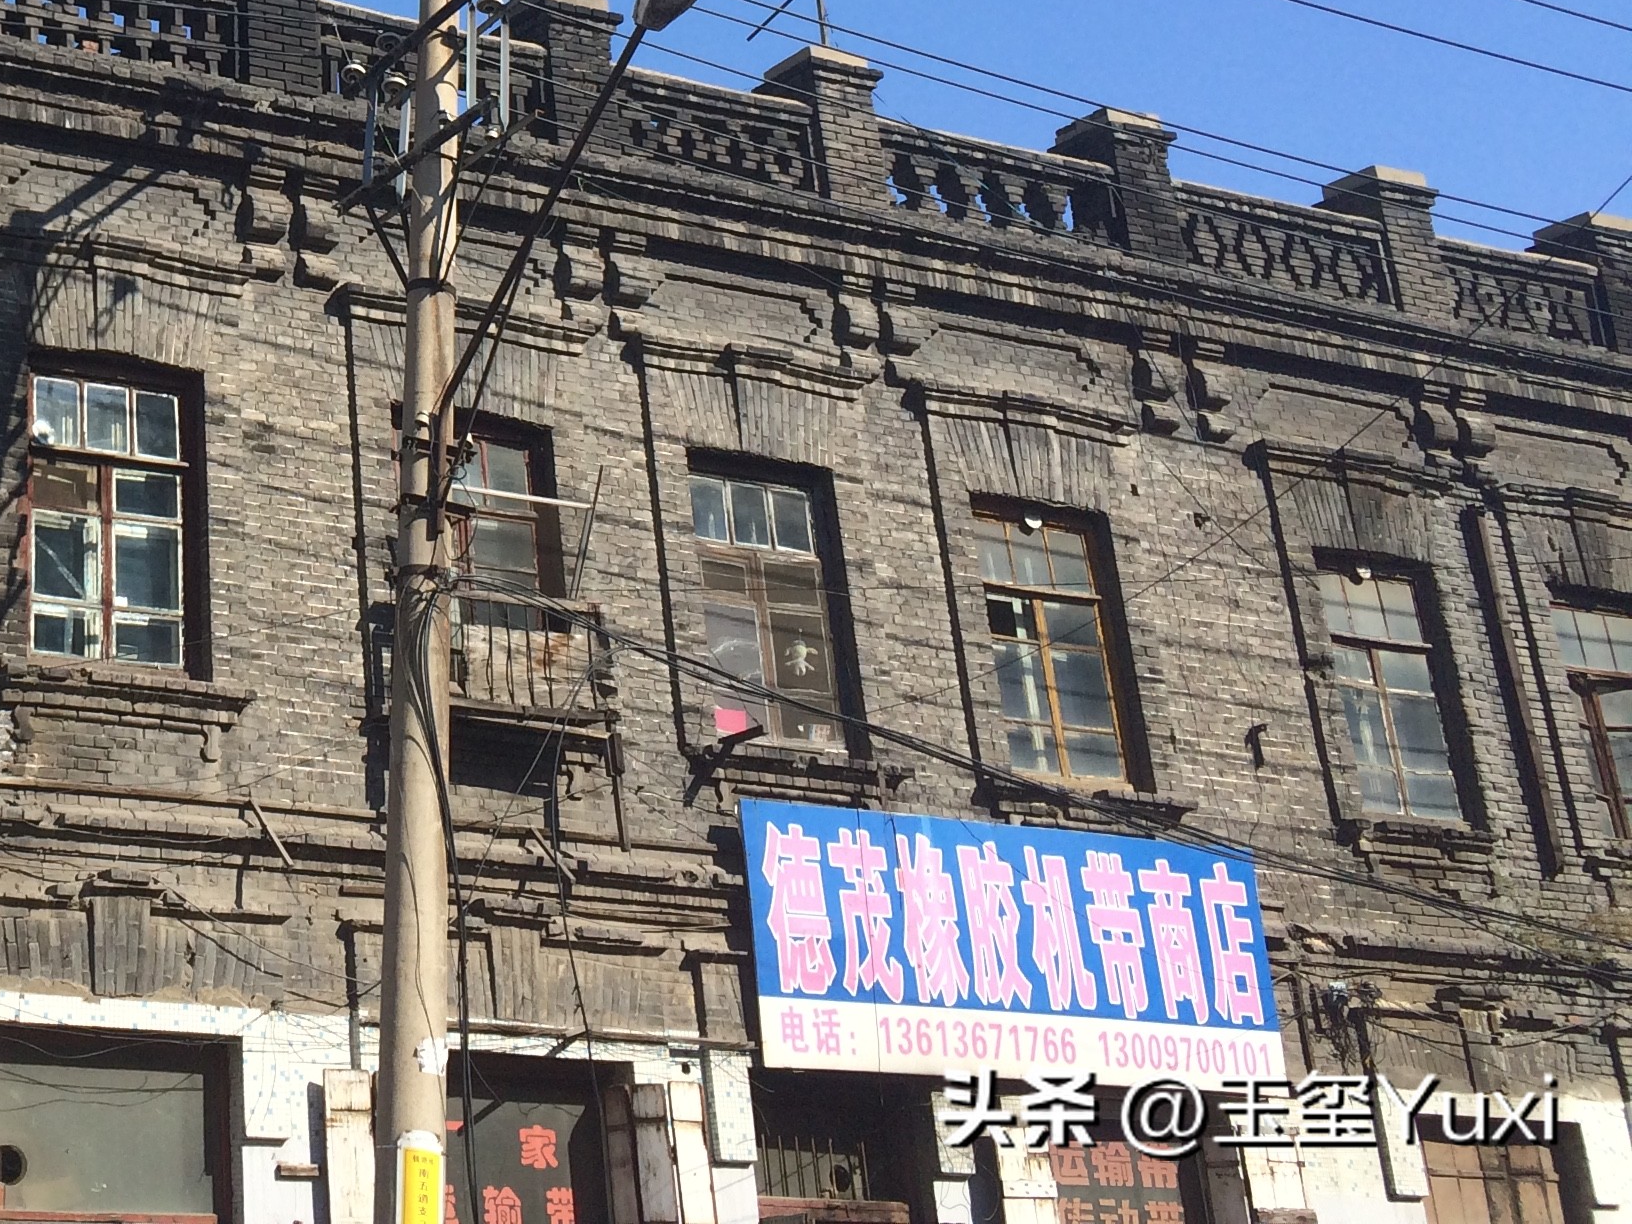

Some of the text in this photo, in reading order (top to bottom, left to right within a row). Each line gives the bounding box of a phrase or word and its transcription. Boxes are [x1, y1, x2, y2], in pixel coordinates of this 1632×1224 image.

[762, 821, 1265, 1025] 德茂橡胶机带商店
[879, 1016, 1077, 1066] 13613671766
[1098, 1030, 1272, 1077] 13009700101
